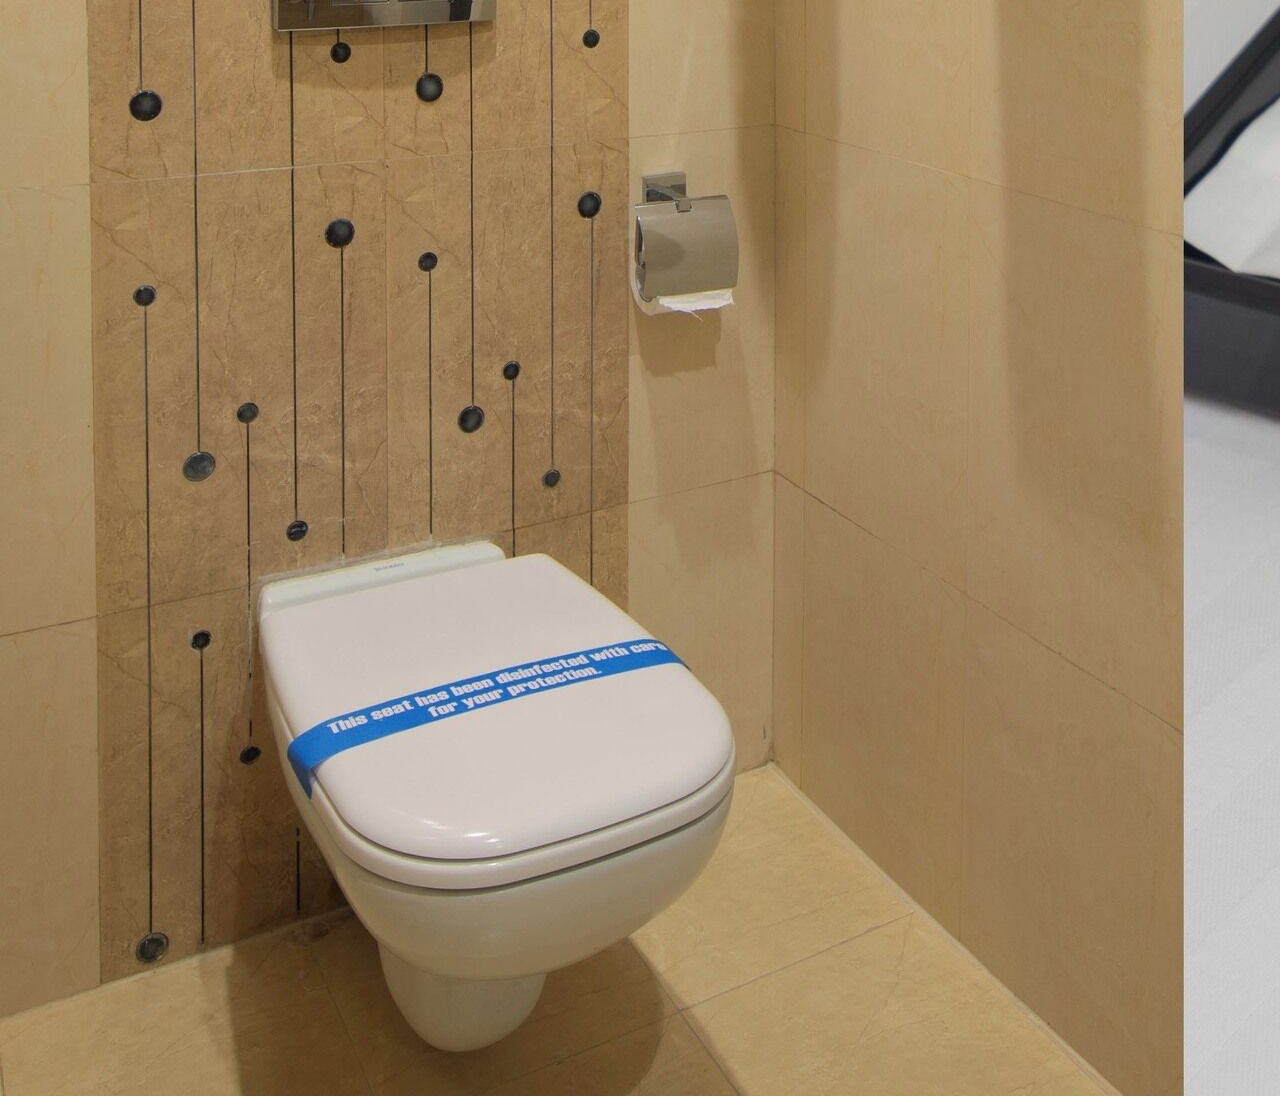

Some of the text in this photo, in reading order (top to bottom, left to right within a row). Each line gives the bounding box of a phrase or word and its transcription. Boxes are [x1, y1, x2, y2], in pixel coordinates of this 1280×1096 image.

[326, 713, 368, 734] This
[370, 700, 415, 721] seat
[414, 690, 450, 708] has
[450, 678, 495, 697] been
[495, 654, 590, 685] disinfected
[589, 645, 630, 662] with
[428, 665, 602, 718] for your protection.
